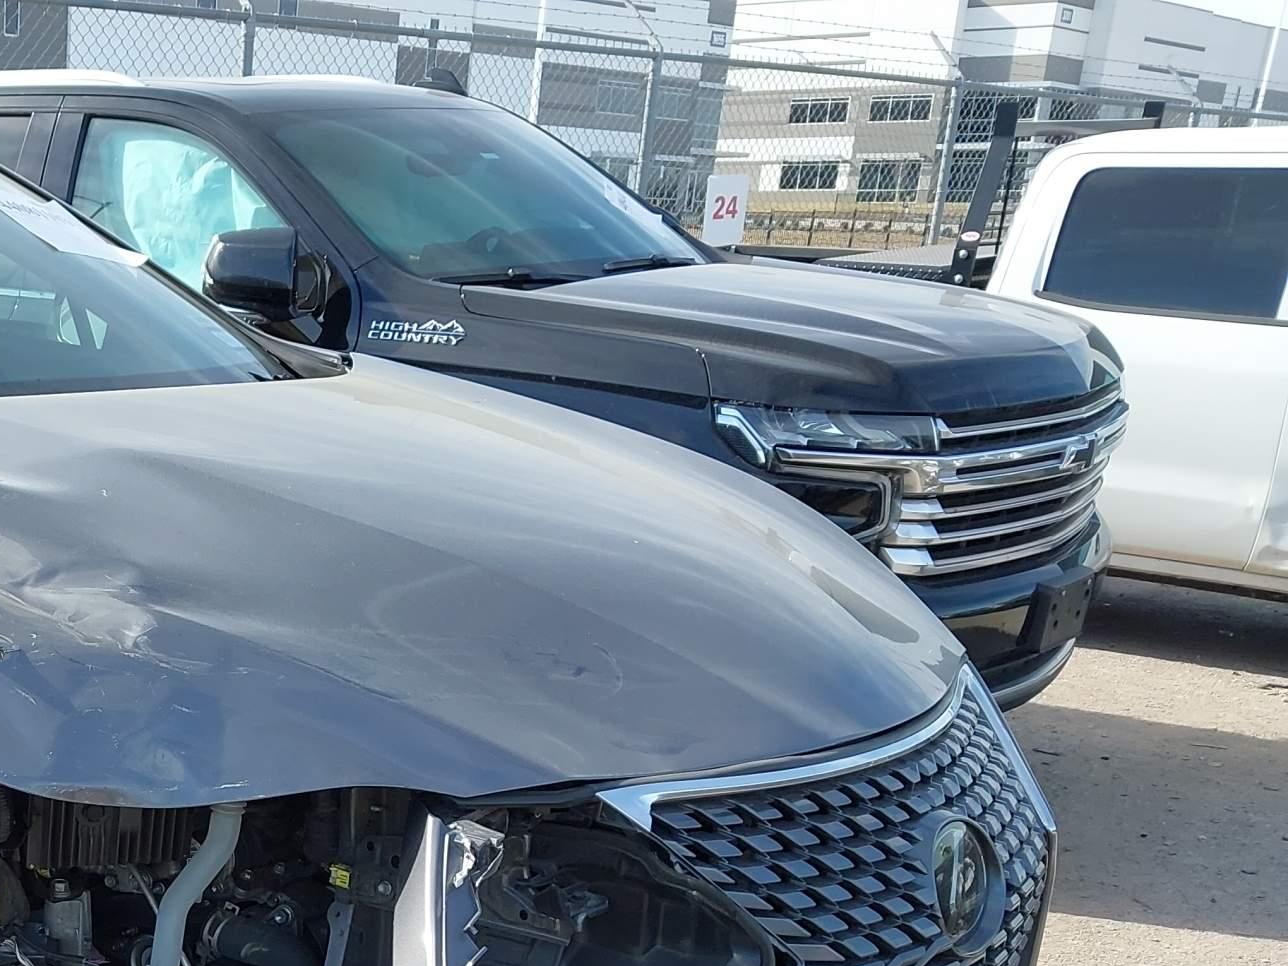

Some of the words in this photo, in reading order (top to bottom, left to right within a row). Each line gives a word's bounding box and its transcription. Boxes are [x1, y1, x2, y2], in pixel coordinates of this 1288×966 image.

[712, 195, 738, 220] 24
[370, 320, 418, 332] HIGH
[368, 330, 465, 345] COUNTRY
